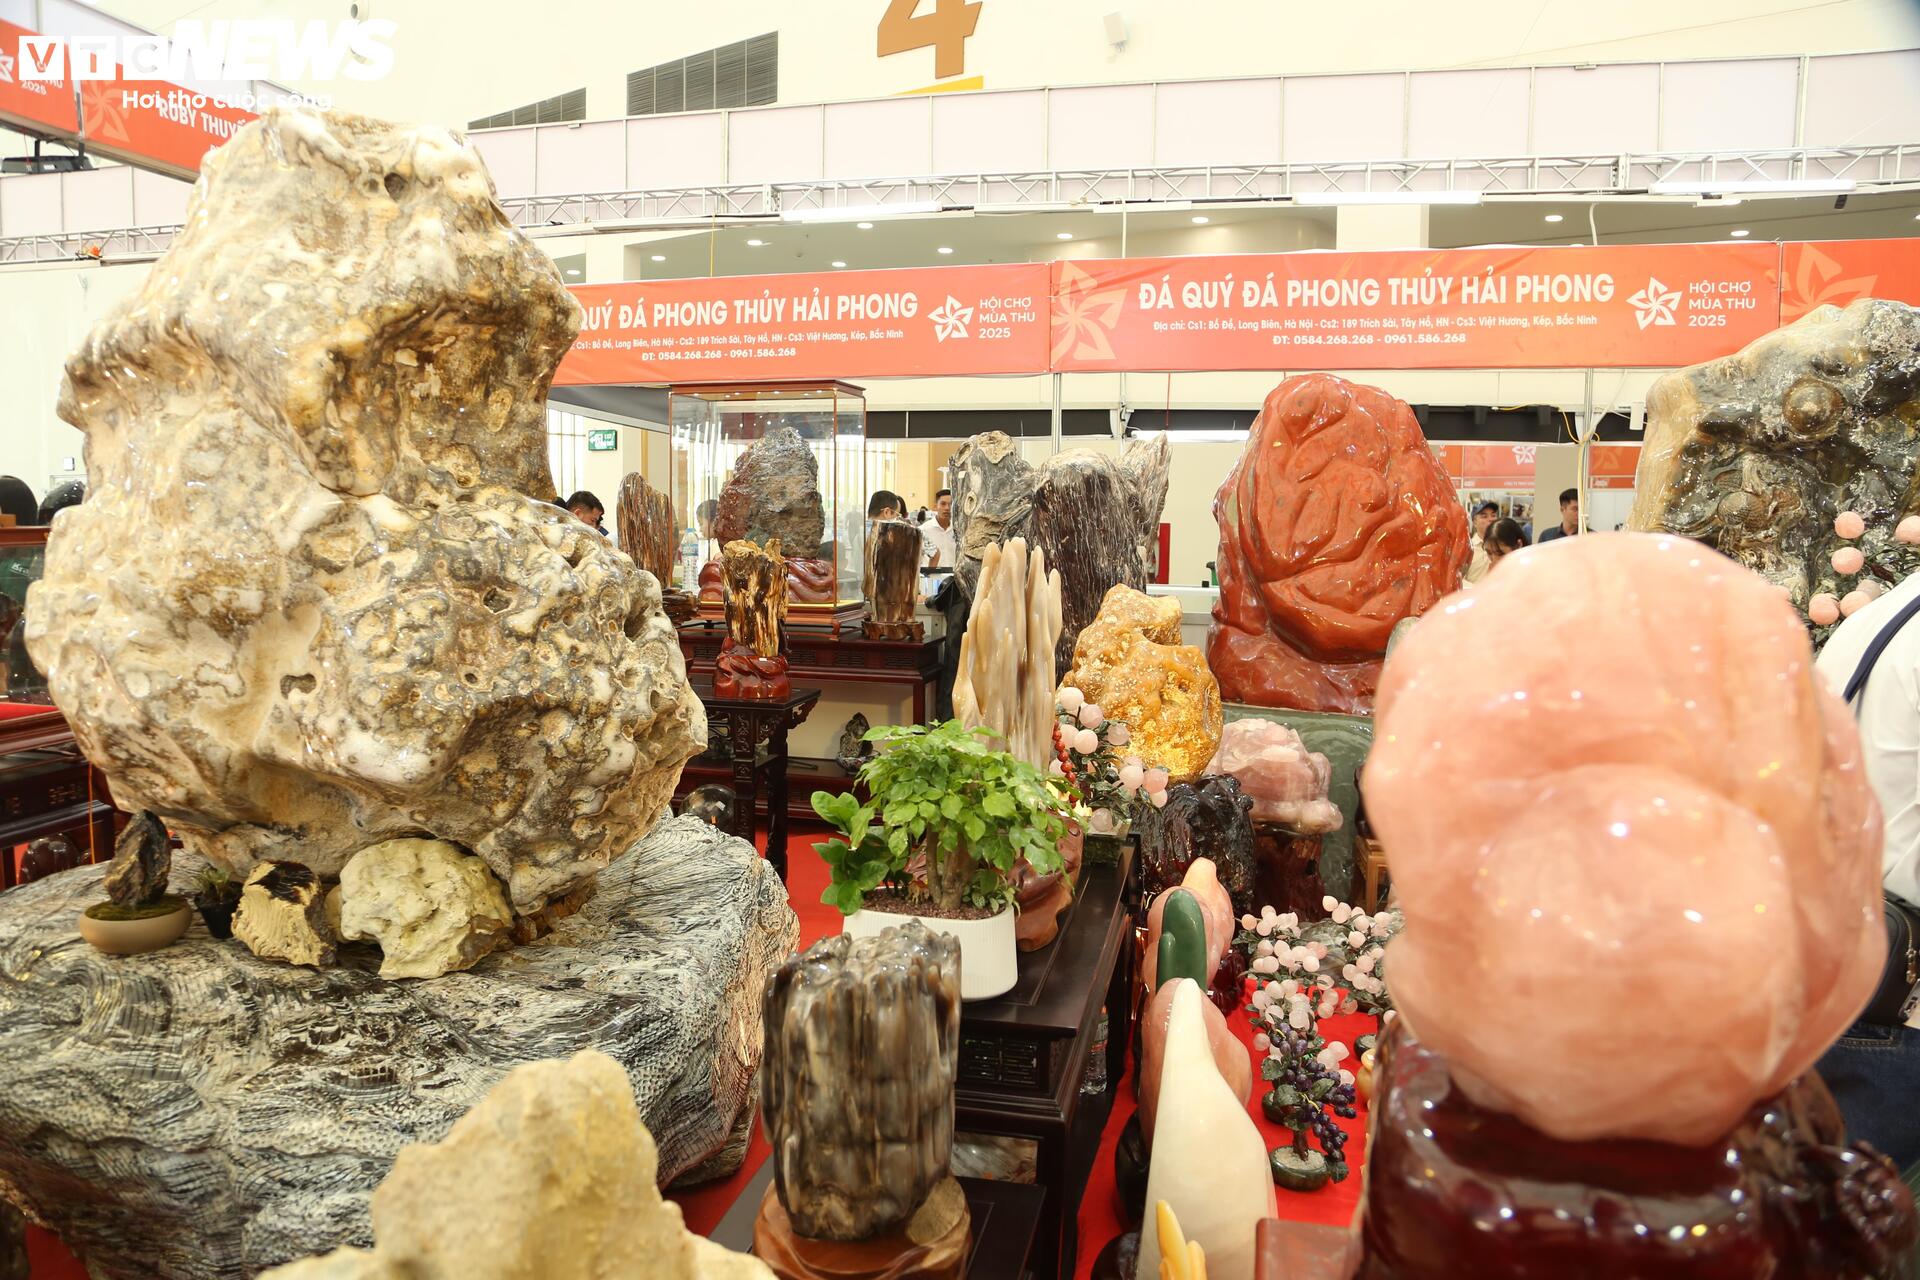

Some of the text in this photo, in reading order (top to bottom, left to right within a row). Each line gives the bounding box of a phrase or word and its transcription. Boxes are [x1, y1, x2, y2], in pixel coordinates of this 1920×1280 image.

[876, 0, 983, 79] 4
[159, 98, 246, 139] RUBY THUY
[1138, 265, 1615, 310] ĐÁ QUÝ ĐÁ PHONG THỦY HẢI PHONG
[1689, 280, 1752, 297] HỘI CHỢ
[618, 297, 648, 329] ĐÁ
[653, 299, 728, 328] PHONG
[733, 289, 787, 324] THỦY
[792, 287, 830, 322] HẢI
[836, 291, 918, 321] PHONG
[979, 296, 1032, 311] HỘI CHỢ
[1688, 296, 1756, 310] MÙA THU
[979, 310, 1036, 324] MÙA THU
[1153, 321, 1168, 333] Địa
[1187, 320, 1207, 330] Cs1:
[1238, 320, 1259, 332] Long
[1261, 319, 1282, 331] Biên,
[1284, 319, 1297, 329] Hà
[1299, 318, 1313, 331] Nội
[1320, 319, 1339, 329] Cs2:
[1342, 319, 1358, 329] 189
[1359, 317, 1381, 328] Trích
[1400, 317, 1417, 329] Tây
[1436, 317, 1449, 327] HN
[1456, 317, 1477, 327] Cs3:
[1478, 315, 1497, 328] Việt
[1576, 315, 1597, 325] Ninh
[1688, 314, 1726, 327] 2025
[615, 340, 632, 350] Long
[679, 337, 695, 346] Cs2:
[697, 336, 710, 345] 189
[771, 333, 783, 342] HN
[788, 332, 805, 342] Cs3:
[886, 329, 904, 339] Ninh
[978, 327, 1011, 339] 2025
[1272, 335, 1291, 345] ĐT:
[1293, 334, 1374, 345] 0584.268.268
[1384, 333, 1466, 344] 0961.586.268
[658, 350, 722, 361] 0584.268.268
[730, 347, 796, 358] 0961.586.268
